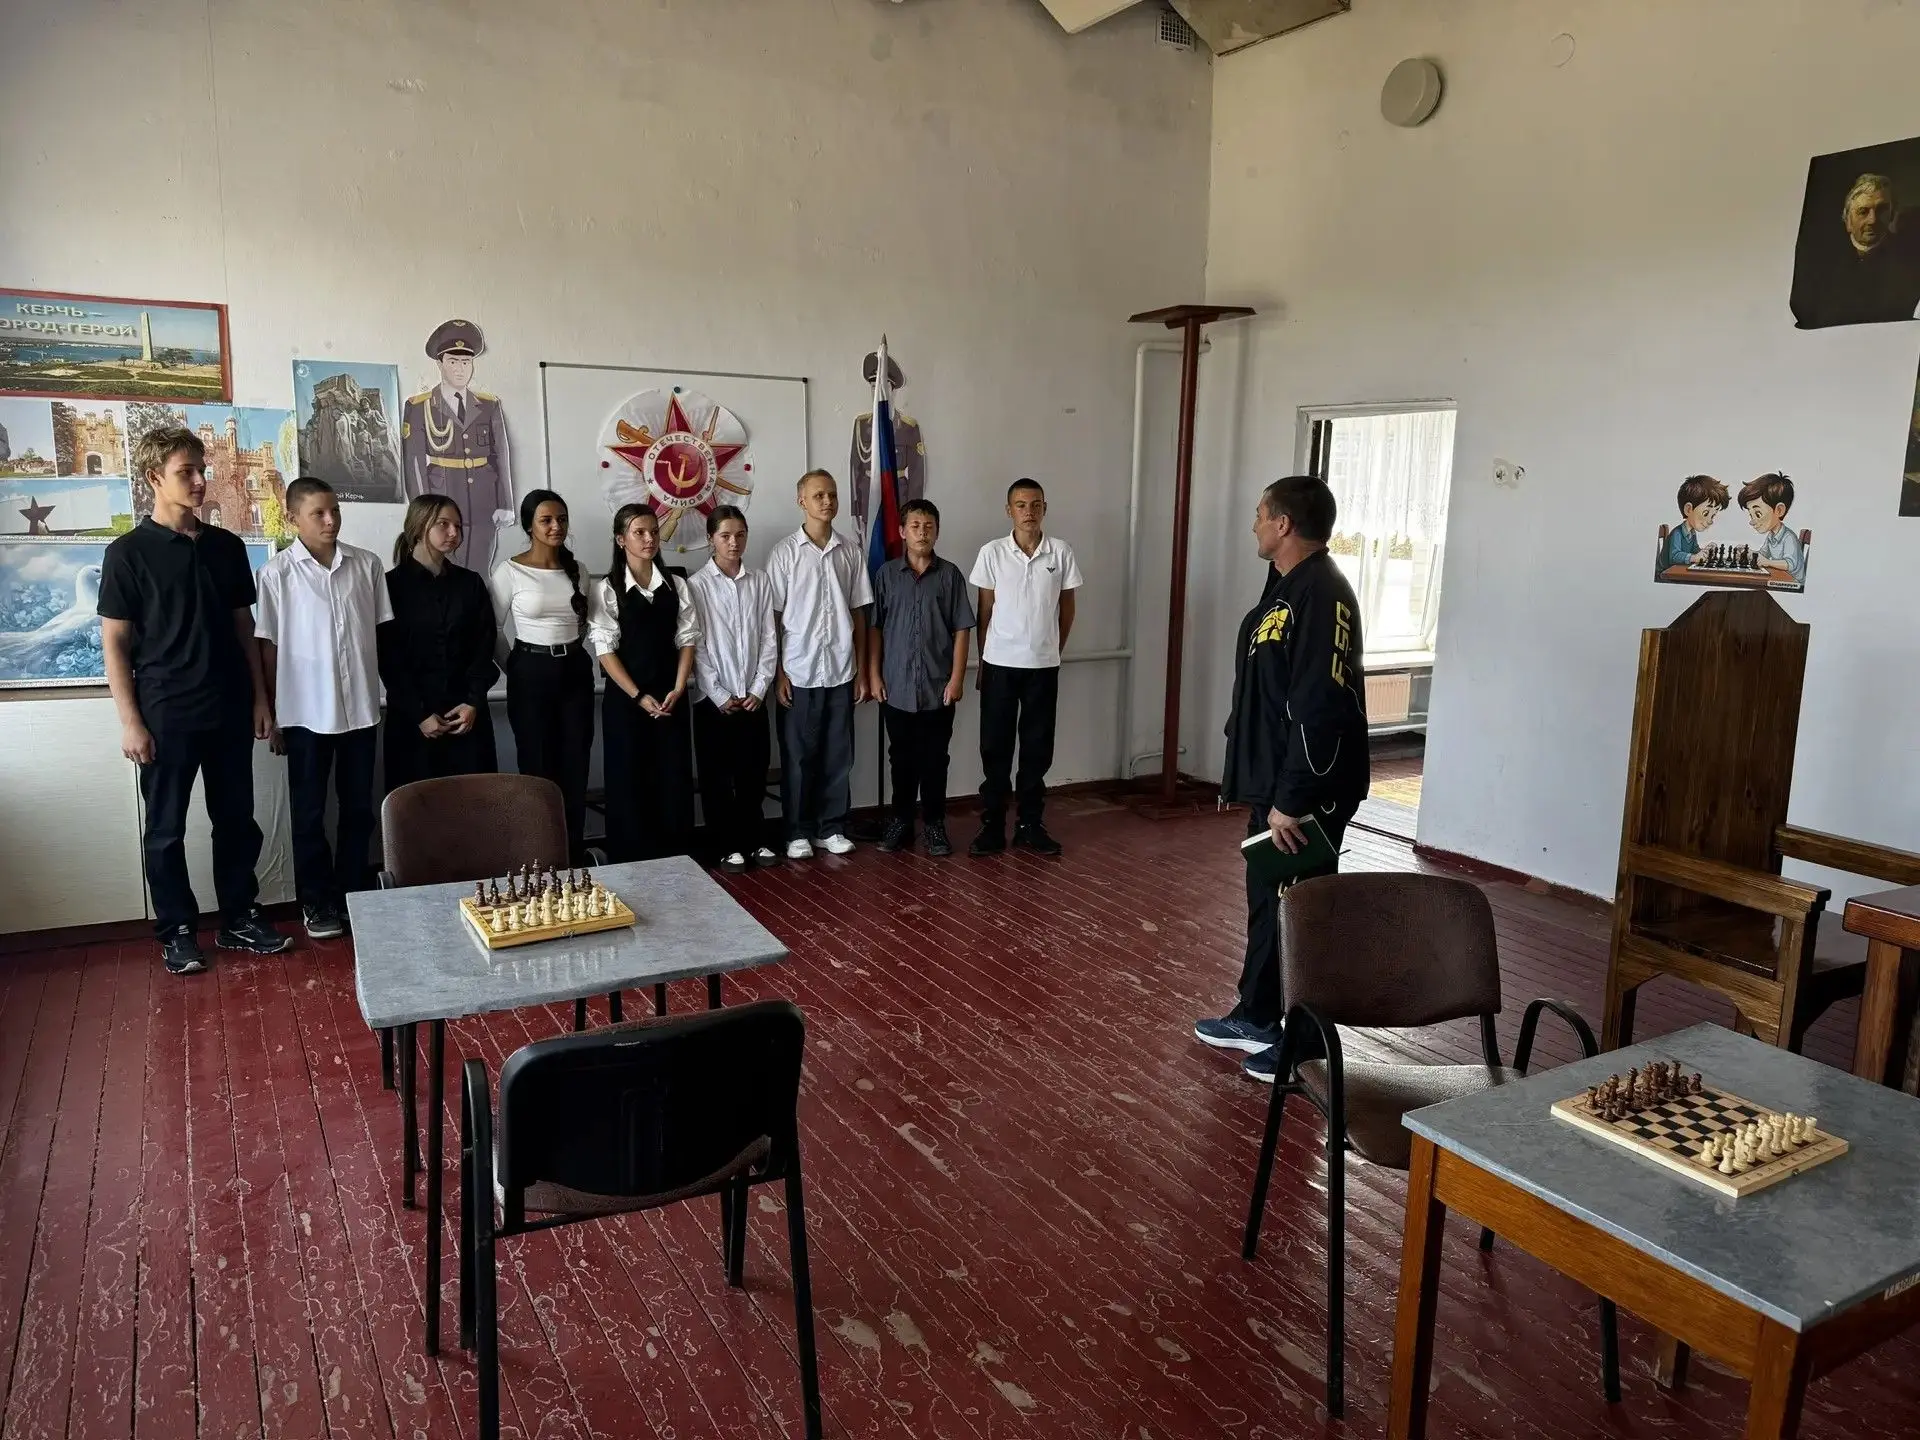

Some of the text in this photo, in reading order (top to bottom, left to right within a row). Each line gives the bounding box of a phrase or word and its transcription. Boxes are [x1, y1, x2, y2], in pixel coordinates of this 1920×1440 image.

[16, 302, 84, 318] КЕРЧЬ
[0, 317, 134, 337] ОРОД-ГЕРОЙ
[648, 434, 716, 508] ОТЕЧЕСТВЕННАЯ ВОЙНА
